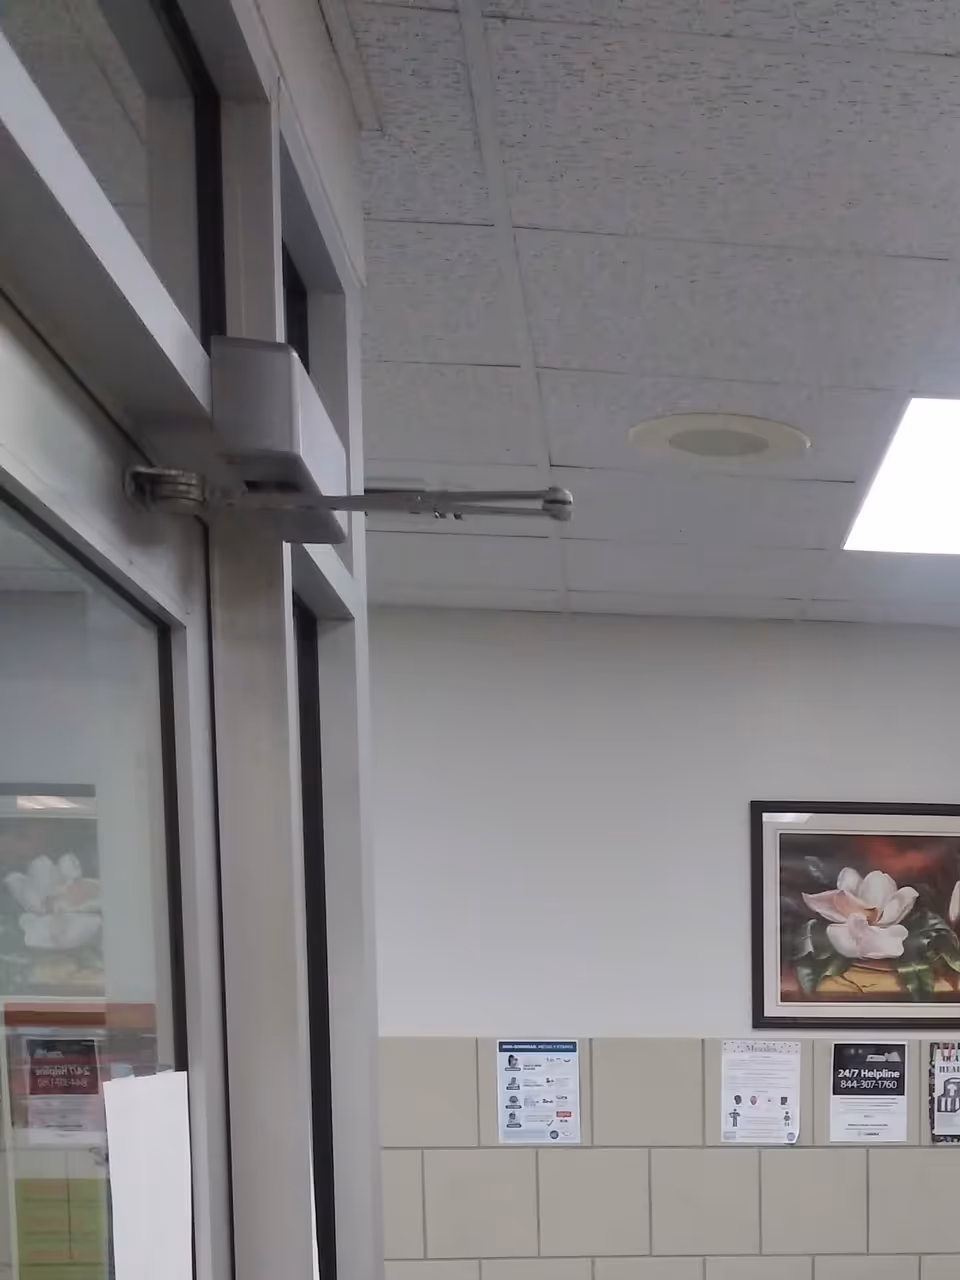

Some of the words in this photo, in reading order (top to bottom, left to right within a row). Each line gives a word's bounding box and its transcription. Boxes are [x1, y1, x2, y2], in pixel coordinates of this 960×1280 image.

[837, 1069, 859, 1078] 24/7
[860, 1068, 900, 1080] Helpline
[840, 1080, 898, 1089] 844-307-1760
